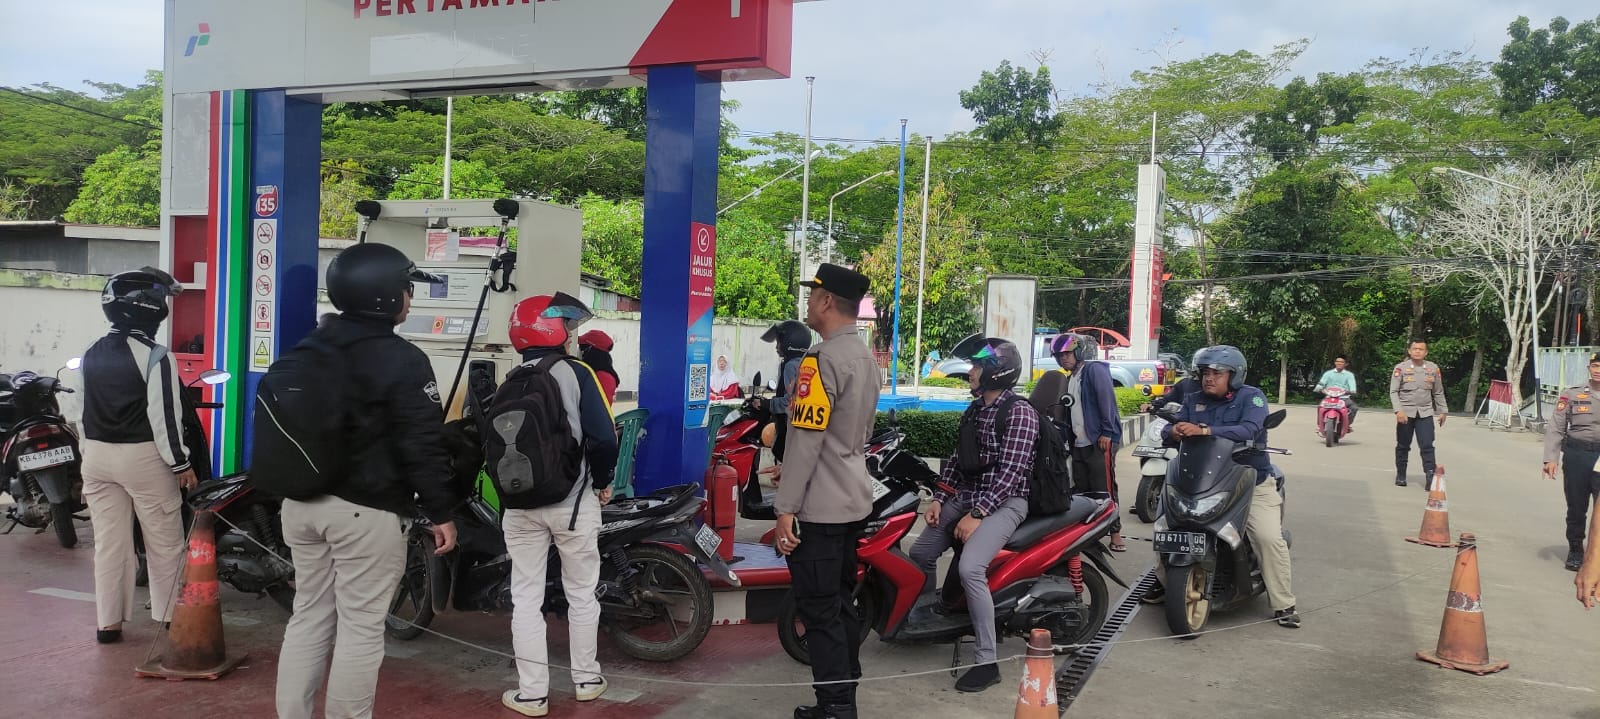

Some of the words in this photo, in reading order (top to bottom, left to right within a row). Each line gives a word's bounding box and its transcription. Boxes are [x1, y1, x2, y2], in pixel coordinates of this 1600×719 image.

[257, 198, 275, 212] 135
[692, 254, 713, 267] JALUR
[692, 267, 713, 277] KHUSUS
[1155, 533, 1166, 542] KB
